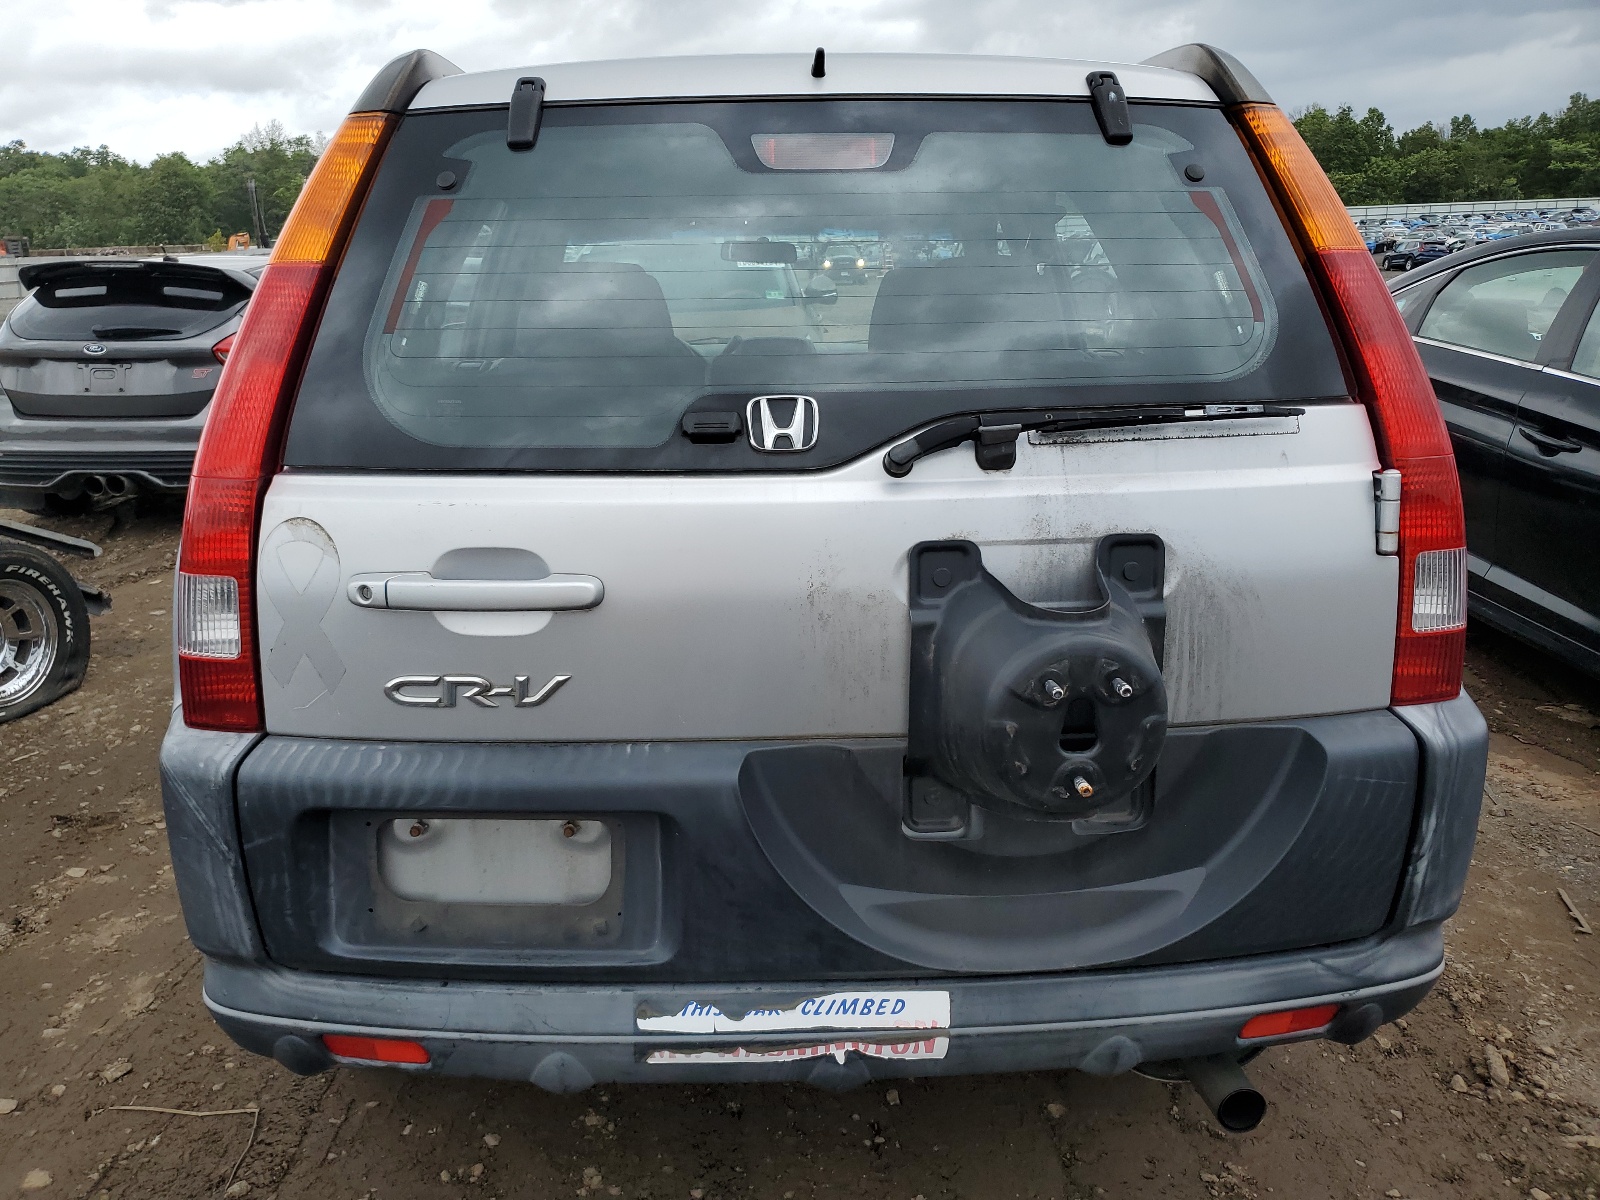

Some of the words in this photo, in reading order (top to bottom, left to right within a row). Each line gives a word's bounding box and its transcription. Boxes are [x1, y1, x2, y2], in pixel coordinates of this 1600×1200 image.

[4, 564, 75, 644] FIREHAWK
[384, 674, 573, 708] CR-V
[800, 997, 906, 1017] CLIMBED
